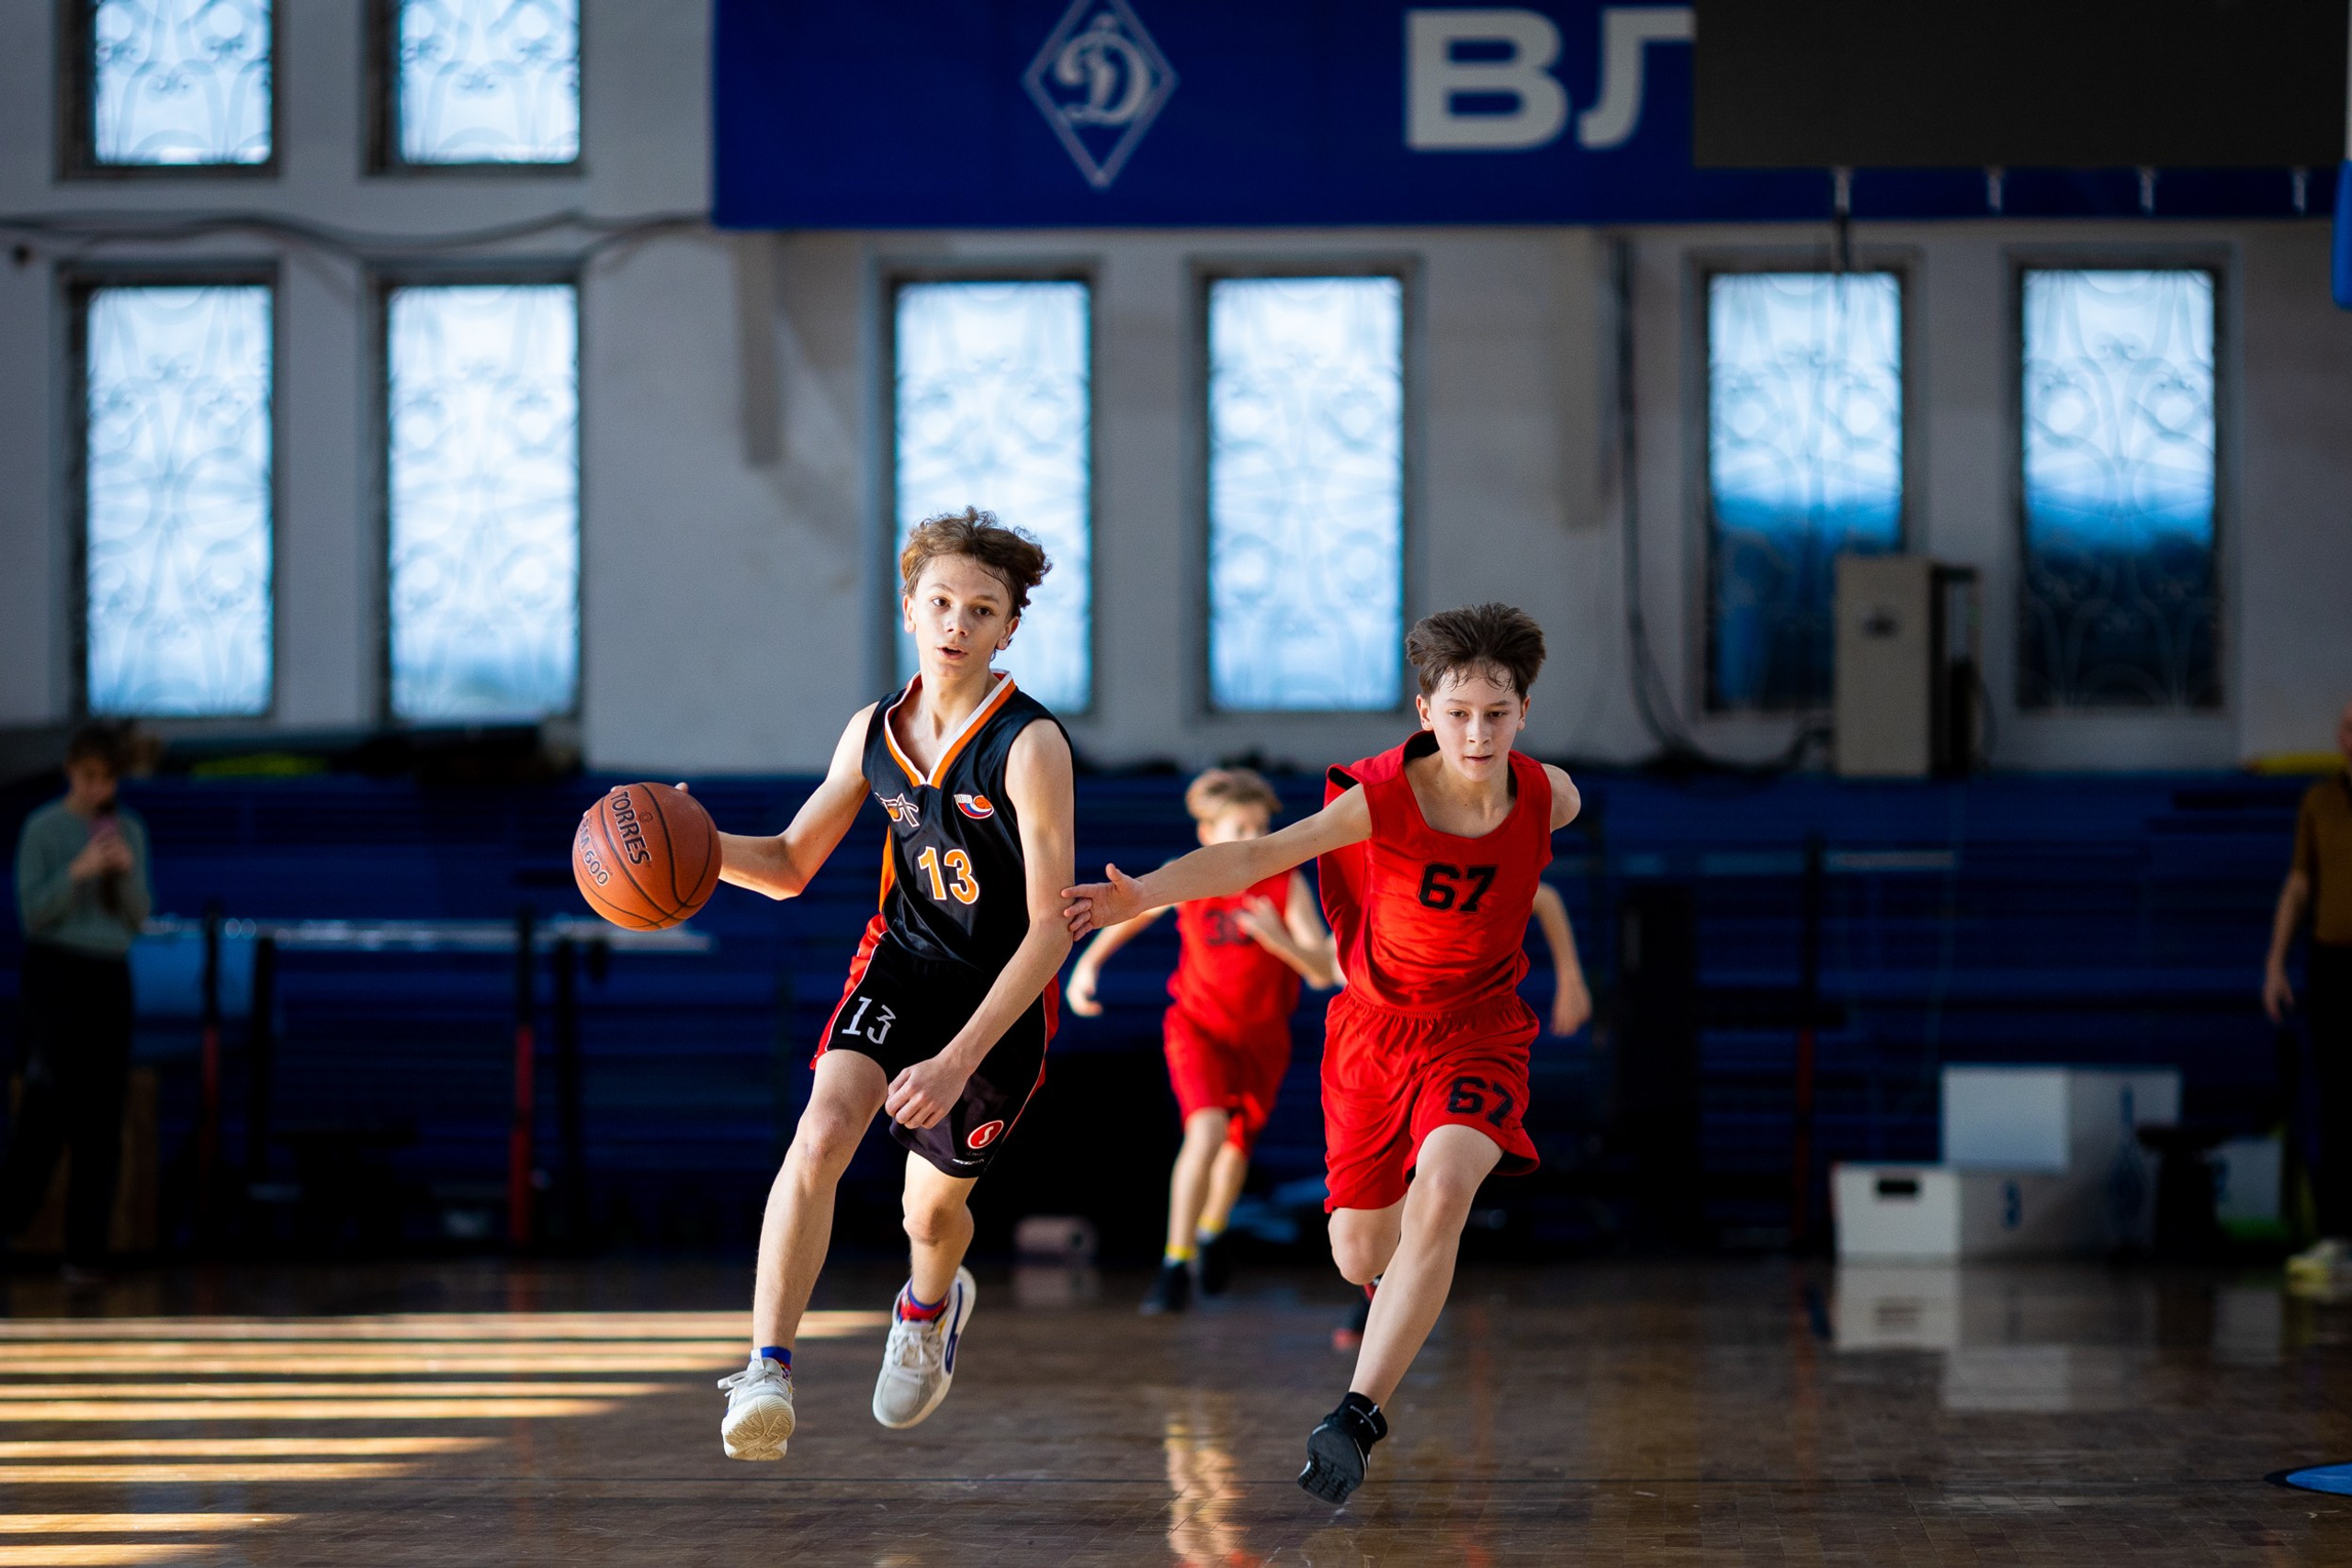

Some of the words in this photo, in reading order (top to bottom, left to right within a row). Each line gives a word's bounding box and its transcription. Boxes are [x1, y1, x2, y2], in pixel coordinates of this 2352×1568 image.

[610, 790, 651, 865] TORRES
[582, 848, 609, 886] 600
[918, 846, 979, 905] 13
[1419, 861, 1498, 914] 67
[842, 996, 897, 1044] 13
[1445, 1076, 1515, 1127] 67
